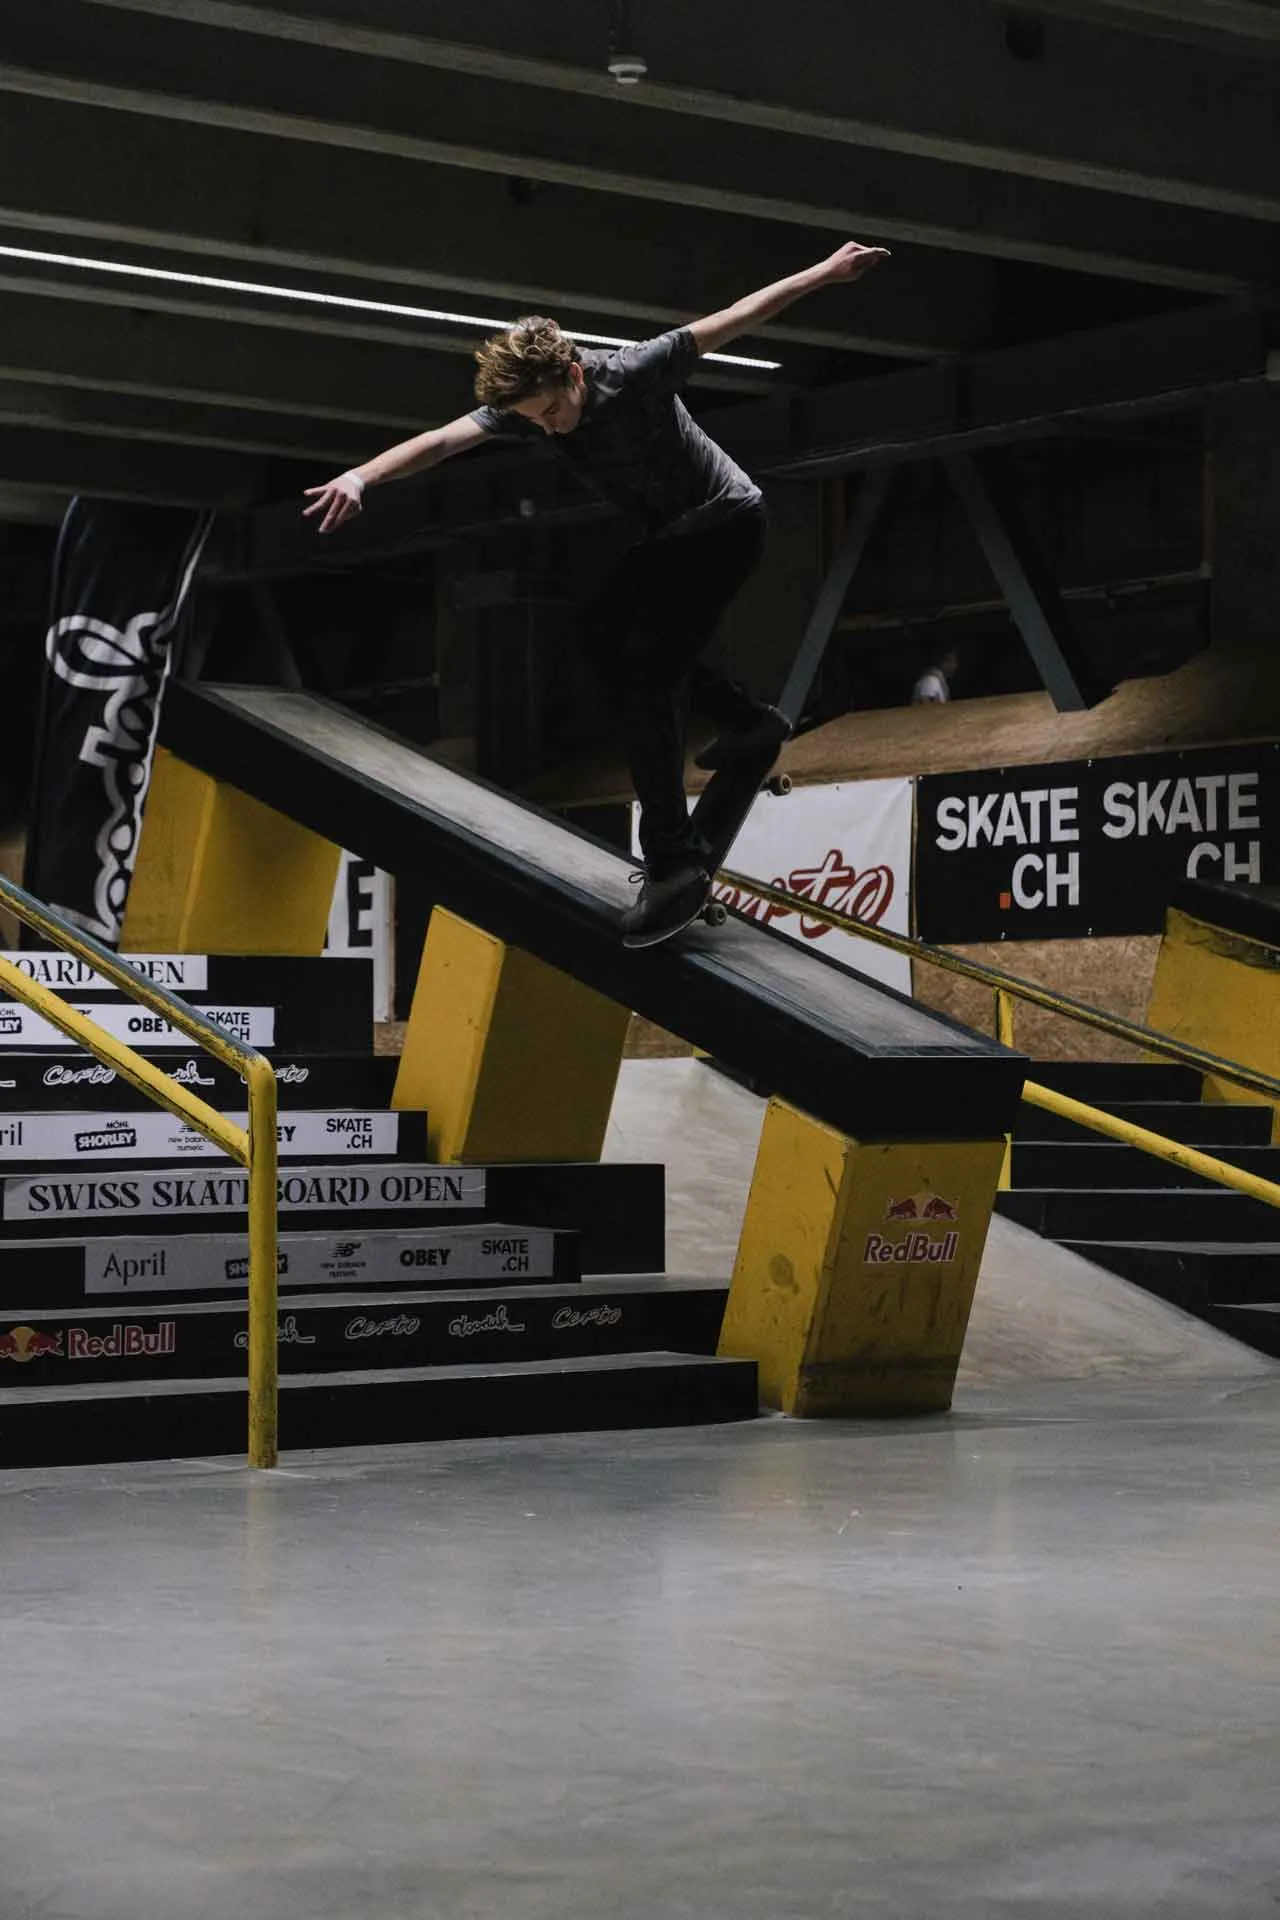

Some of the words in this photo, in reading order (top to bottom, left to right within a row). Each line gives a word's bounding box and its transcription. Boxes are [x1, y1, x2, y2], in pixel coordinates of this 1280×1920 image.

[1102, 773, 1261, 839] SKATE
[936, 787, 1080, 851] SKATE
[999, 852, 1080, 910] .CH
[206, 1012, 250, 1026] SKATE
[326, 1118, 373, 1133] SKATE
[78, 1131, 135, 1149] SHORLEY
[346, 1135, 373, 1149] .CH
[28, 1182, 141, 1212] SWISS
[380, 1176, 464, 1203] OPEN
[481, 1239, 529, 1255] SKATE
[103, 1250, 166, 1286] April
[400, 1250, 452, 1267] OBEY
[501, 1256, 529, 1272] .CH
[344, 1313, 420, 1341] Certo
[551, 1304, 622, 1330] Certo
